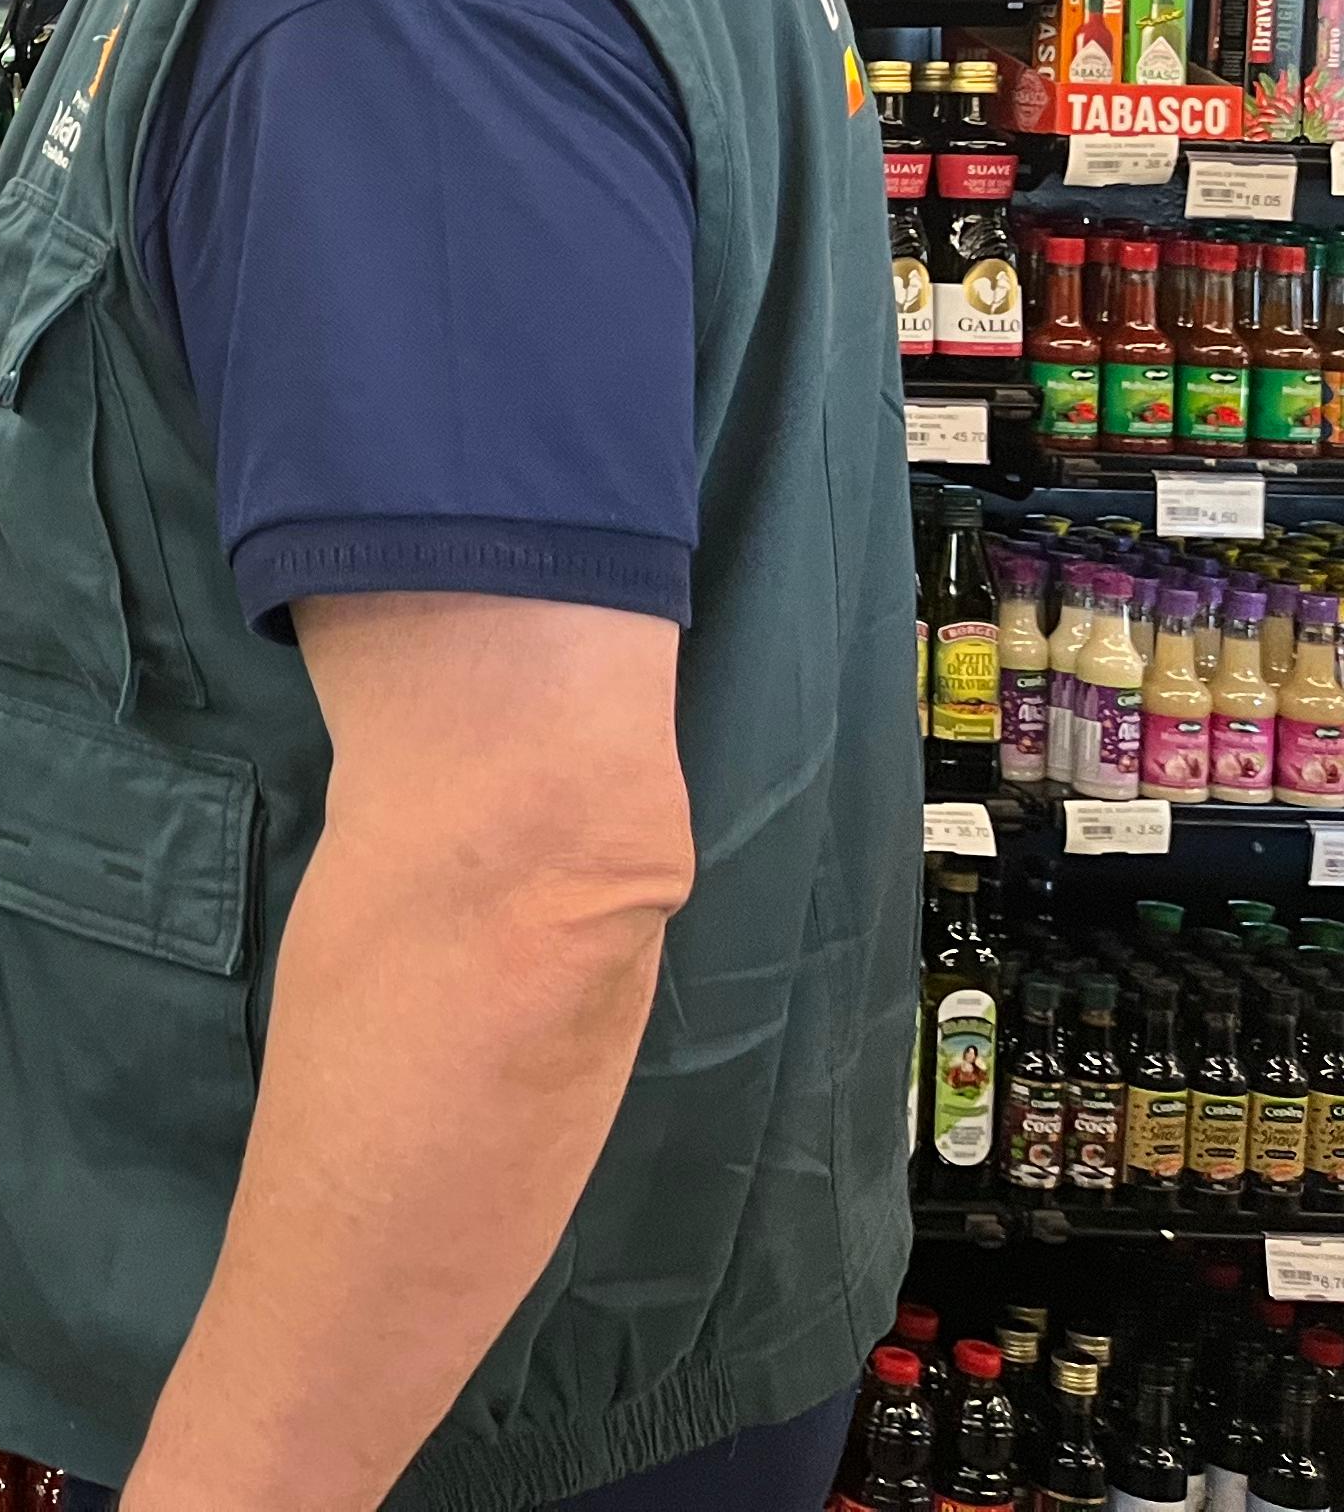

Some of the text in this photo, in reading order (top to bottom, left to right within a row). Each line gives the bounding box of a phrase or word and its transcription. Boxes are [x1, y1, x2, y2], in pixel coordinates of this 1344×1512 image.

[1327, 27, 1341, 68] Bravo
[1068, 95, 1227, 135] TABASCO
[884, 163, 924, 176] SUAVE
[967, 164, 1011, 177] SUAVE
[958, 318, 1021, 334] GALLO
